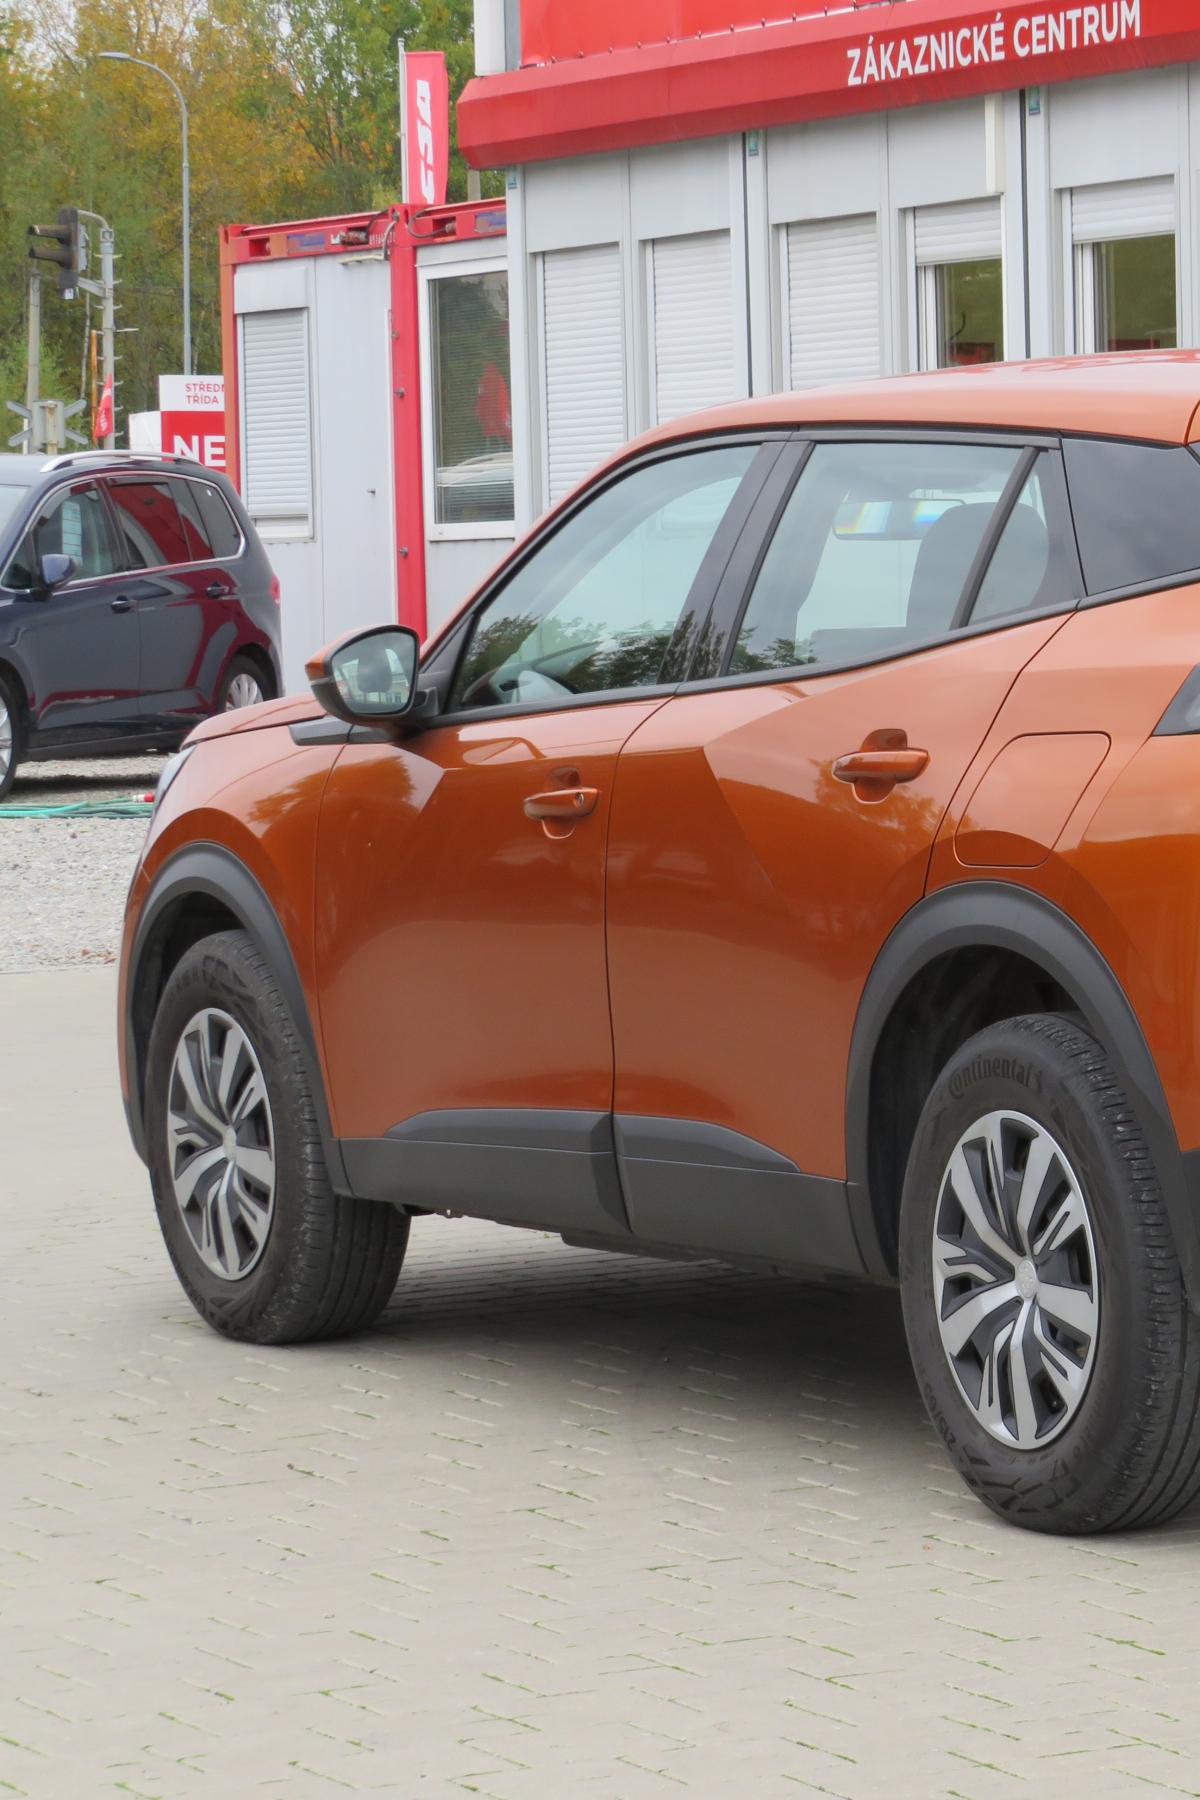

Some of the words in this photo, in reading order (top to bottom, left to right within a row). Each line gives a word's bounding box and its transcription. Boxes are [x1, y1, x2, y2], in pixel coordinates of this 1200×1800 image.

[847, 12, 1006, 86] ZÁKAZNICKÉ
[1012, 0, 1141, 58] CENTRUM
[186, 393, 219, 405] TŘÍDA
[948, 1054, 1031, 1100] Continental
